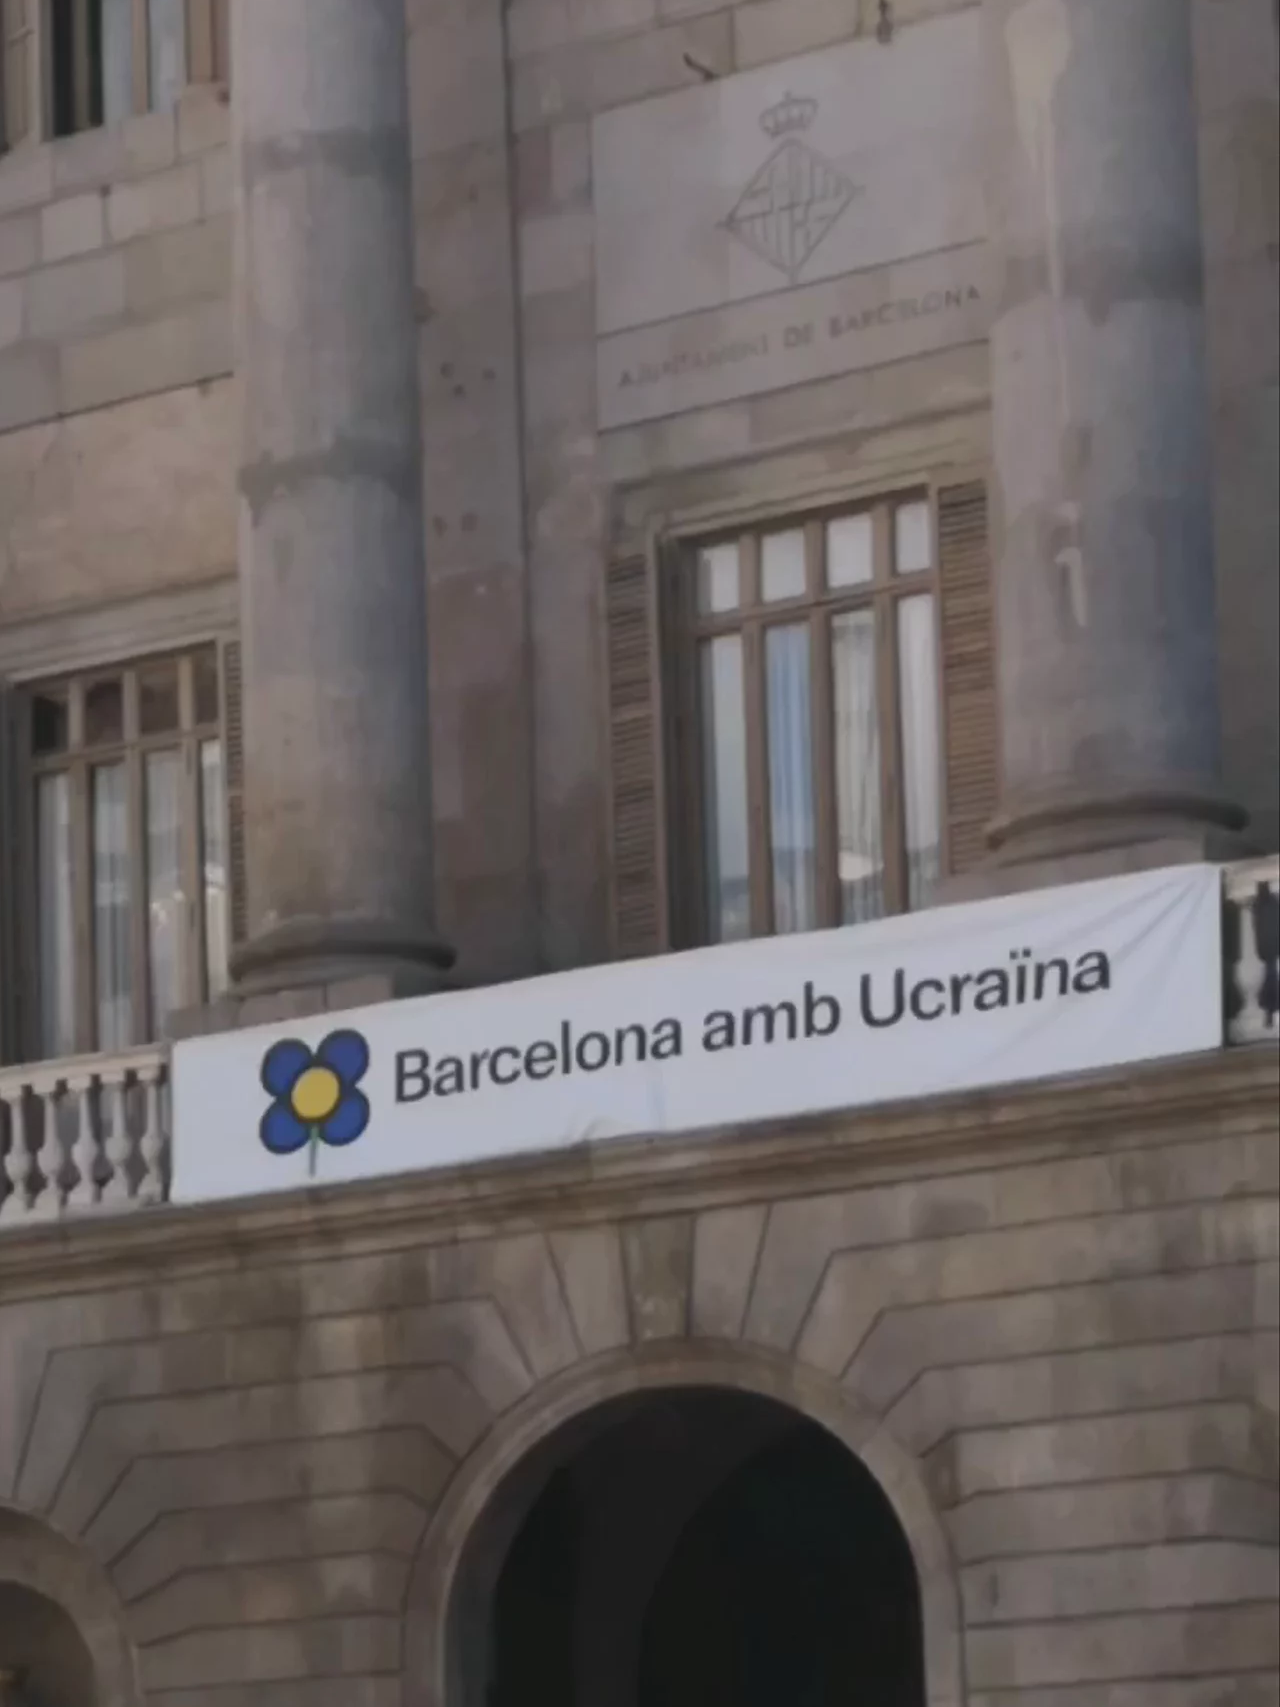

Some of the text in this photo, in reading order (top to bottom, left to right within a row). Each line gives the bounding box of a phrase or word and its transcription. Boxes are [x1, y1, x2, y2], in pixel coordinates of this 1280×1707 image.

[396, 949, 1110, 1102] Barcelona amb Ucraïna
